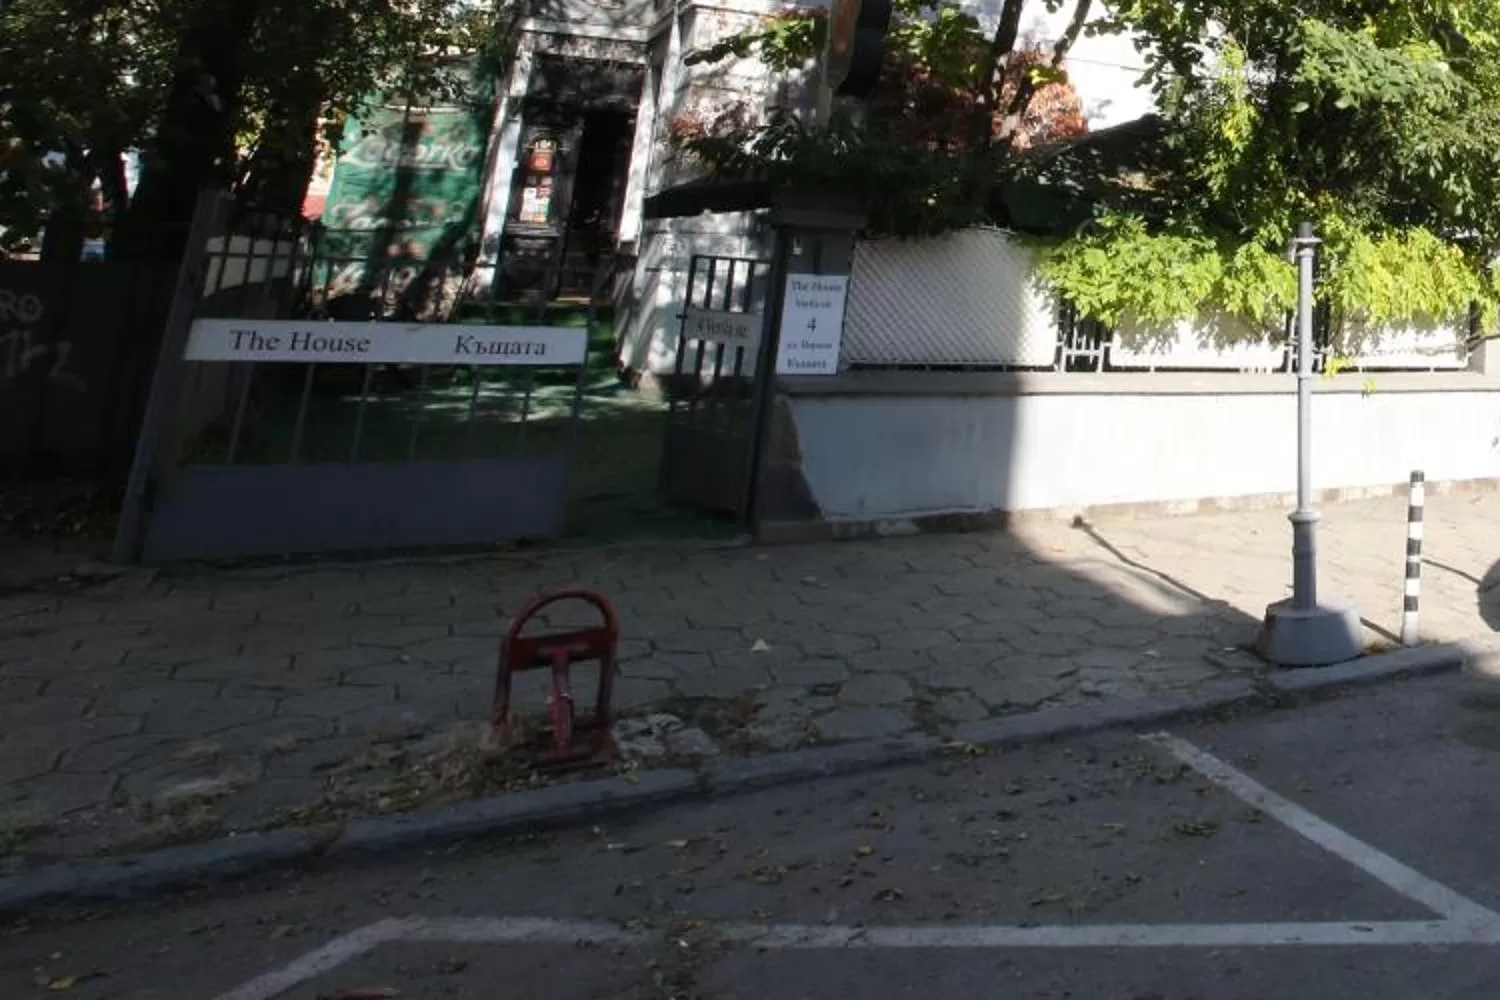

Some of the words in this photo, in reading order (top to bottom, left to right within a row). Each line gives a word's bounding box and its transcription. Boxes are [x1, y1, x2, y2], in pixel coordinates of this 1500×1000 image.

[807, 316, 817, 333] 4
[229, 329, 281, 351] The
[288, 331, 372, 353] House
[454, 335, 547, 356] Къщата
